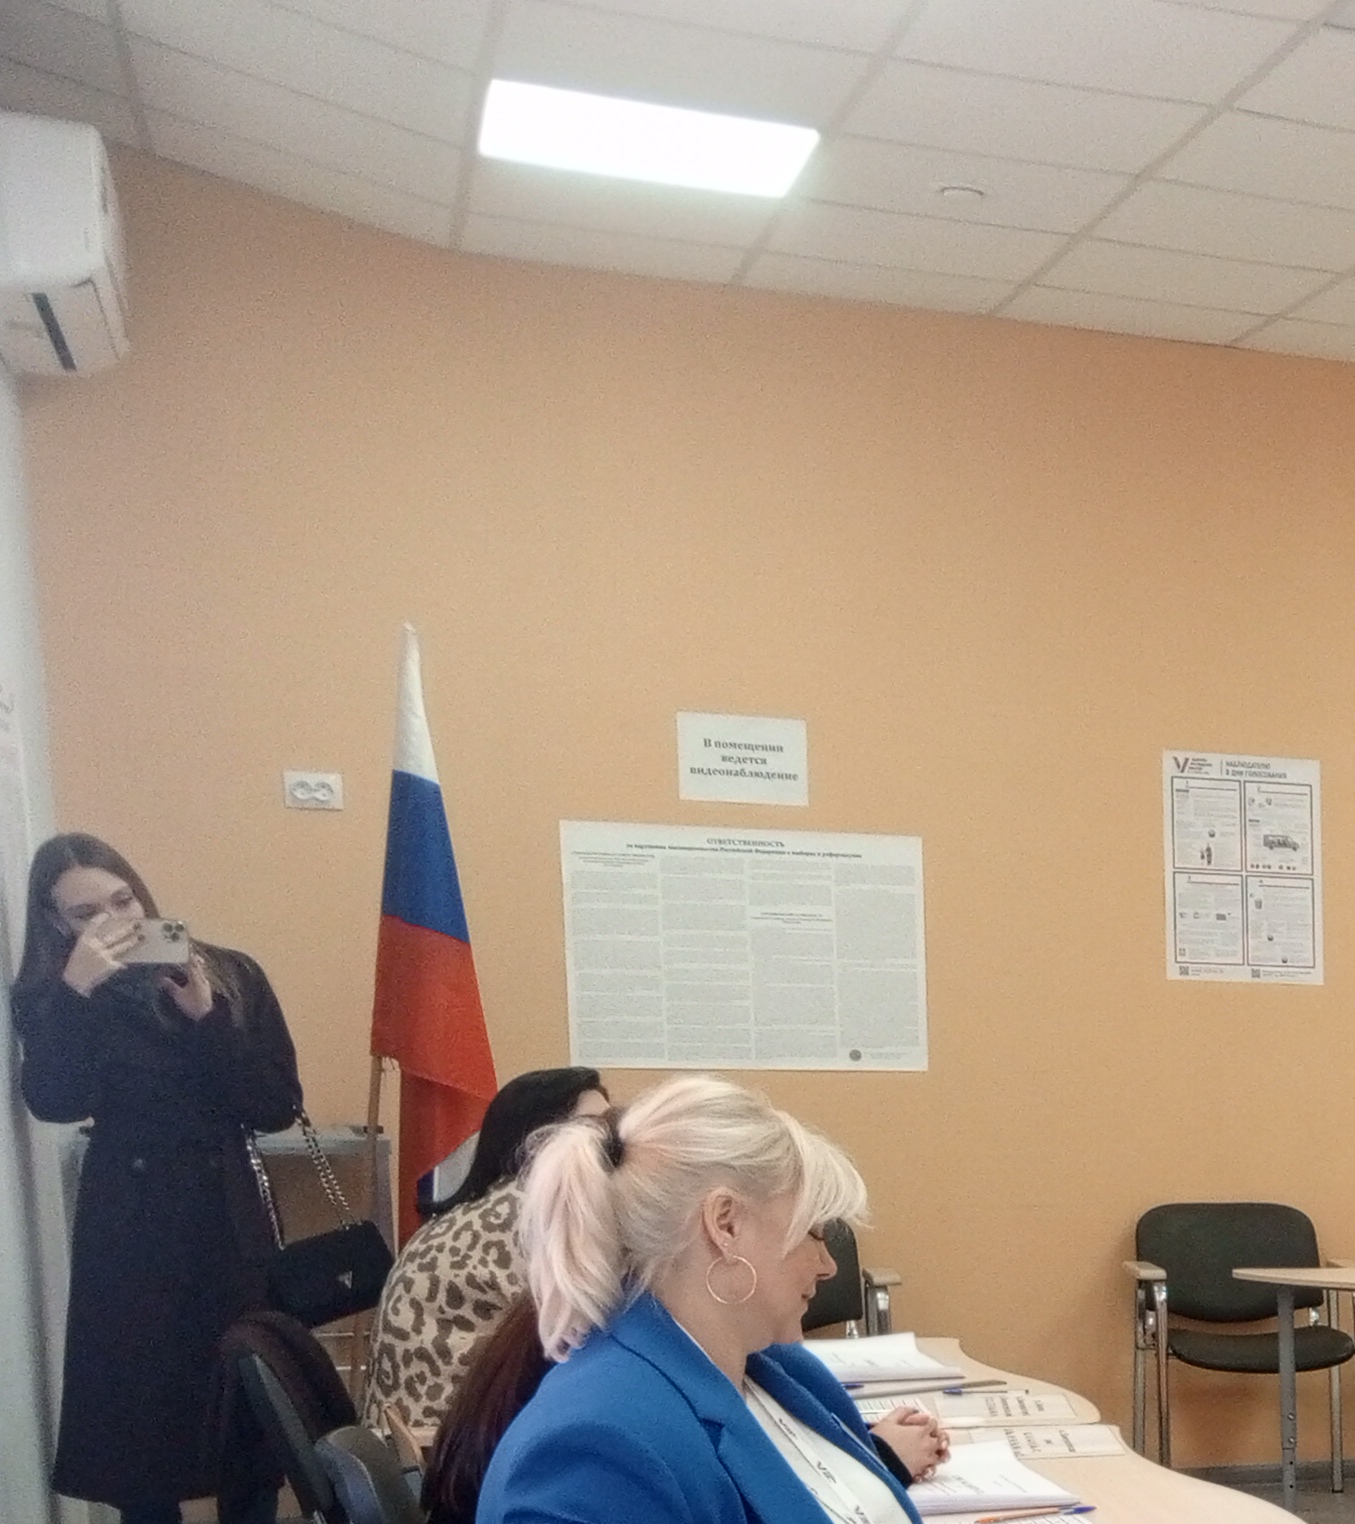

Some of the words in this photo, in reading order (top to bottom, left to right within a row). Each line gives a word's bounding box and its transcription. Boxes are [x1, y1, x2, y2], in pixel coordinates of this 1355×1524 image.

[703, 738, 712, 748] В
[714, 740, 784, 753] помещении
[721, 755, 767, 765] ведется
[690, 766, 799, 781] видеонаблюдение
[706, 837, 785, 848] ОТВЕТСТВЕННОСТЬ
